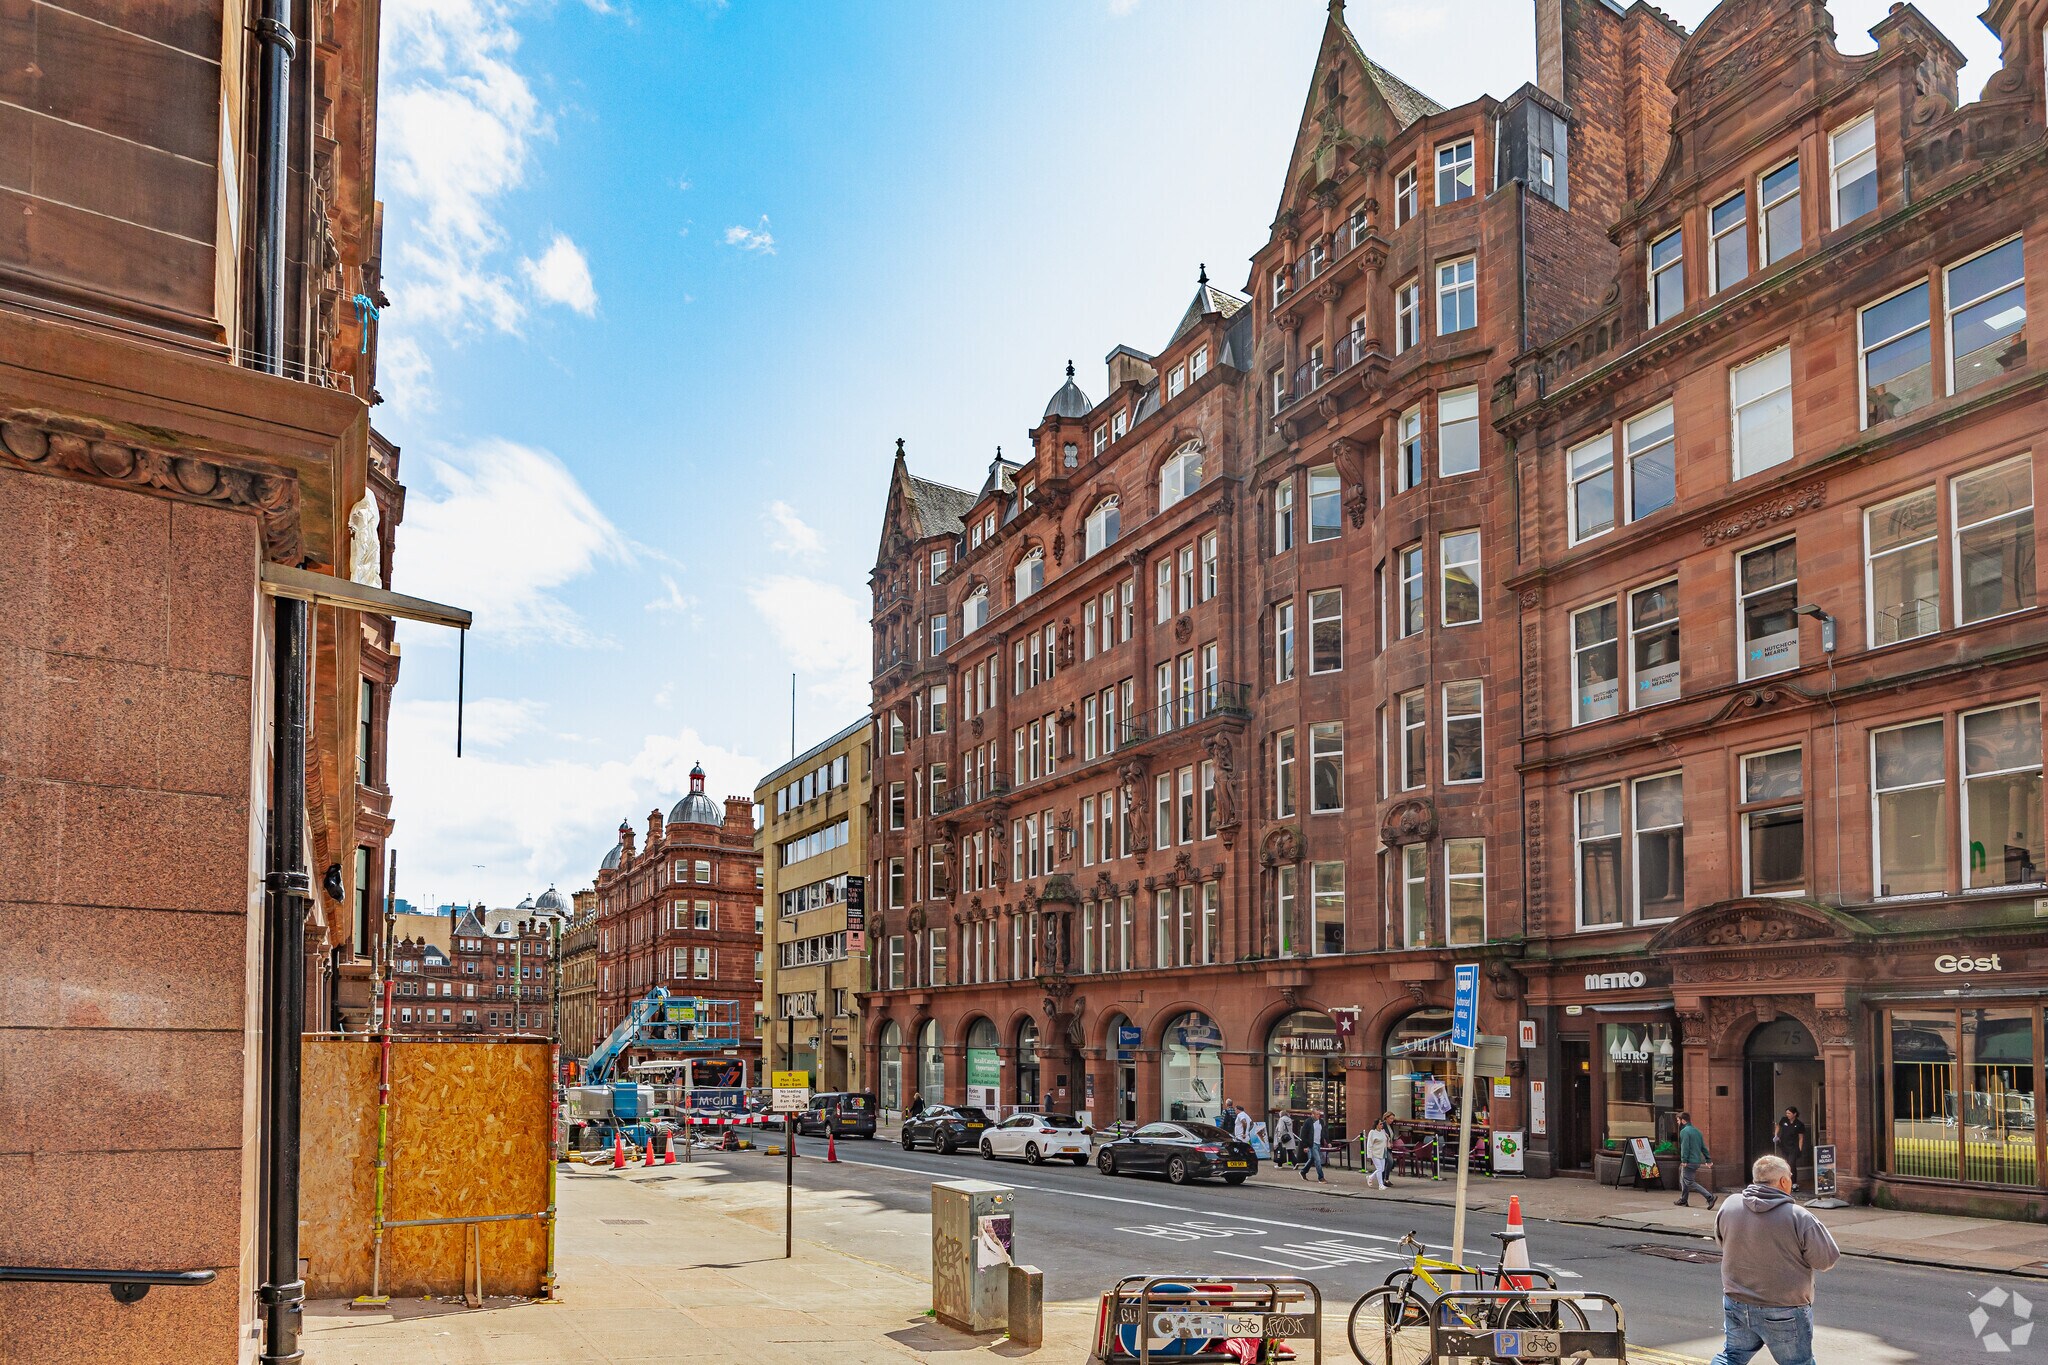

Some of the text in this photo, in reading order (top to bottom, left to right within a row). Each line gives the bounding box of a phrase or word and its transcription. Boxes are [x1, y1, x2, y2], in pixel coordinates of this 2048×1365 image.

[1764, 639, 1797, 653] HUTCHEON
[1764, 647, 1789, 657] MEARNS
[1651, 672, 1680, 682] HUTCHEON
[1651, 678, 1673, 687] MEARNS
[1593, 694, 1613, 703] MEARNS
[1585, 971, 1647, 990] METRO
[1290, 1037, 1334, 1050] PRET A MANGER
[1780, 1031, 1801, 1045] 75
[1413, 1038, 1430, 1052] PRET
[1432, 1038, 1438, 1052] A
[1611, 1051, 1649, 1061] METRO
[717, 1067, 740, 1087] X7
[700, 1096, 736, 1105] McGill'
[1114, 1221, 1268, 1242] BUS
[1500, 1333, 1516, 1355] P
